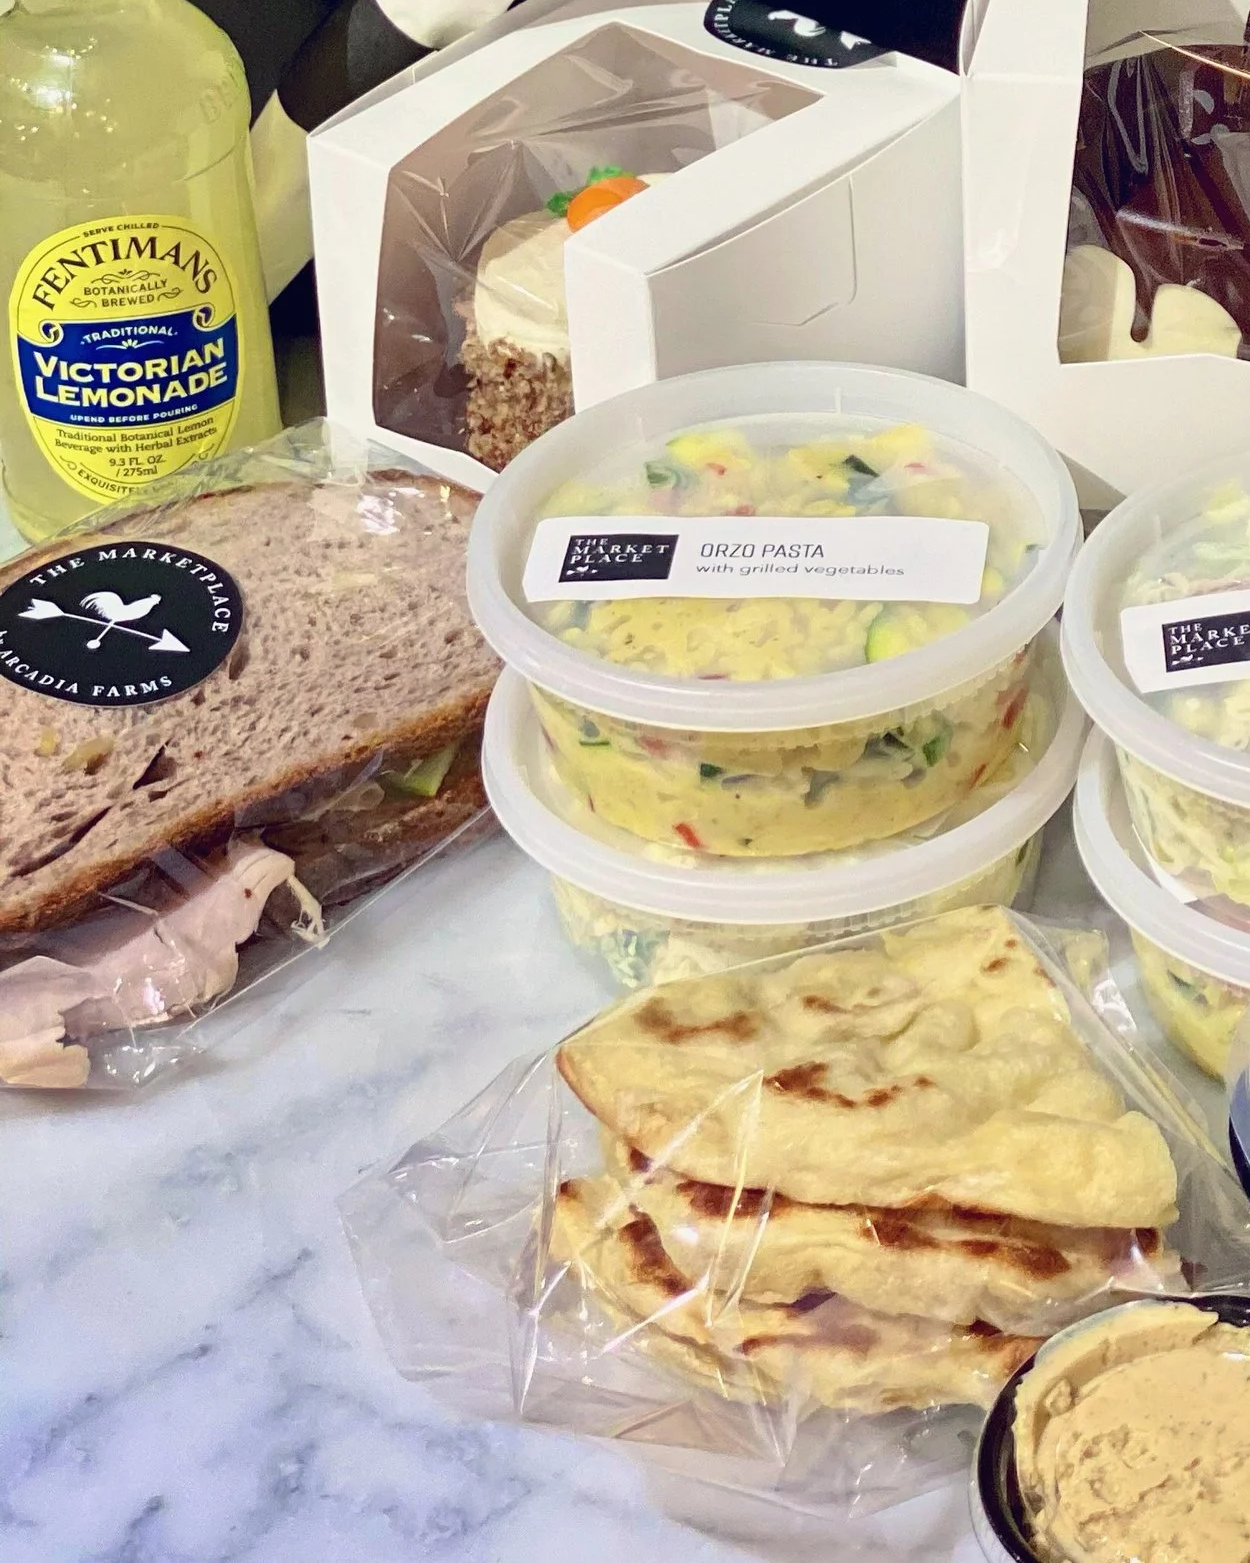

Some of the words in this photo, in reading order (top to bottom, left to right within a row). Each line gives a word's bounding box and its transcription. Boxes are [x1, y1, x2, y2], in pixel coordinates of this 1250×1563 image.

[83, 224, 114, 238] SERVE
[117, 222, 160, 231] CHILLED
[32, 236, 218, 311] FENTIMANS
[83, 278, 168, 296] BOTANICALLY
[101, 294, 155, 307] BREWED
[82, 326, 174, 344] TRADITIONAL
[33, 337, 225, 383] VICTORIAN
[35, 362, 229, 408] LEMONADE
[70, 414, 105, 423] UPEND
[108, 413, 150, 424] BEFORE
[153, 404, 199, 420] POURING
[56, 428, 117, 442] Traditional
[120, 427, 174, 442] Botanical
[178, 417, 214, 435] Lemon
[54, 439, 104, 454] Beverage
[106, 442, 132, 453] with
[135, 439, 174, 452] Herbal
[176, 427, 218, 446] Extracts
[109, 457, 125, 466] 9.3
[123, 465, 158, 477] 275ml
[571, 544, 670, 555] MARKET
[574, 538, 608, 547] THE
[700, 543, 755, 558] ORZO
[761, 543, 825, 559] PASTA
[570, 553, 643, 564] PLACE
[696, 564, 734, 575] with
[739, 563, 799, 577] grilled
[804, 564, 905, 577] vegetables
[30, 557, 85, 587] THE
[98, 548, 232, 634] MARKETPLACE
[1168, 623, 1203, 635] THE
[1170, 636, 1245, 655] PLACE
[0, 649, 78, 694] ARCADIA
[92, 676, 173, 697] FARMS
